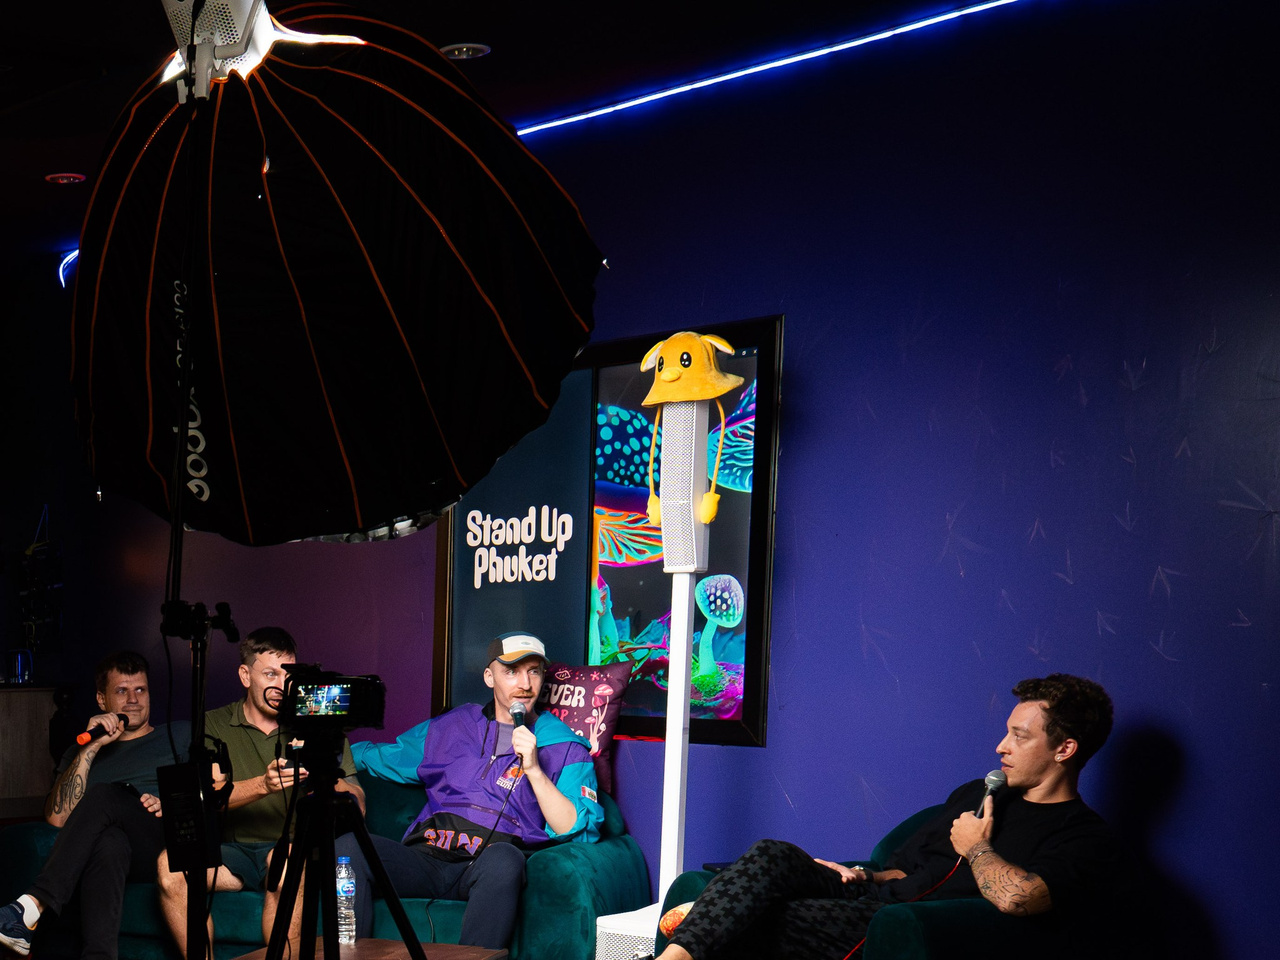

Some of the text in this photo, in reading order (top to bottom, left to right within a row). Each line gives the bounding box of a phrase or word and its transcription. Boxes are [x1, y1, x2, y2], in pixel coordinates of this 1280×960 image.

[466, 505, 573, 551] Stand Up
[473, 545, 559, 589] Phuket
[538, 682, 587, 708] EVER
[423, 828, 486, 856] SUN
